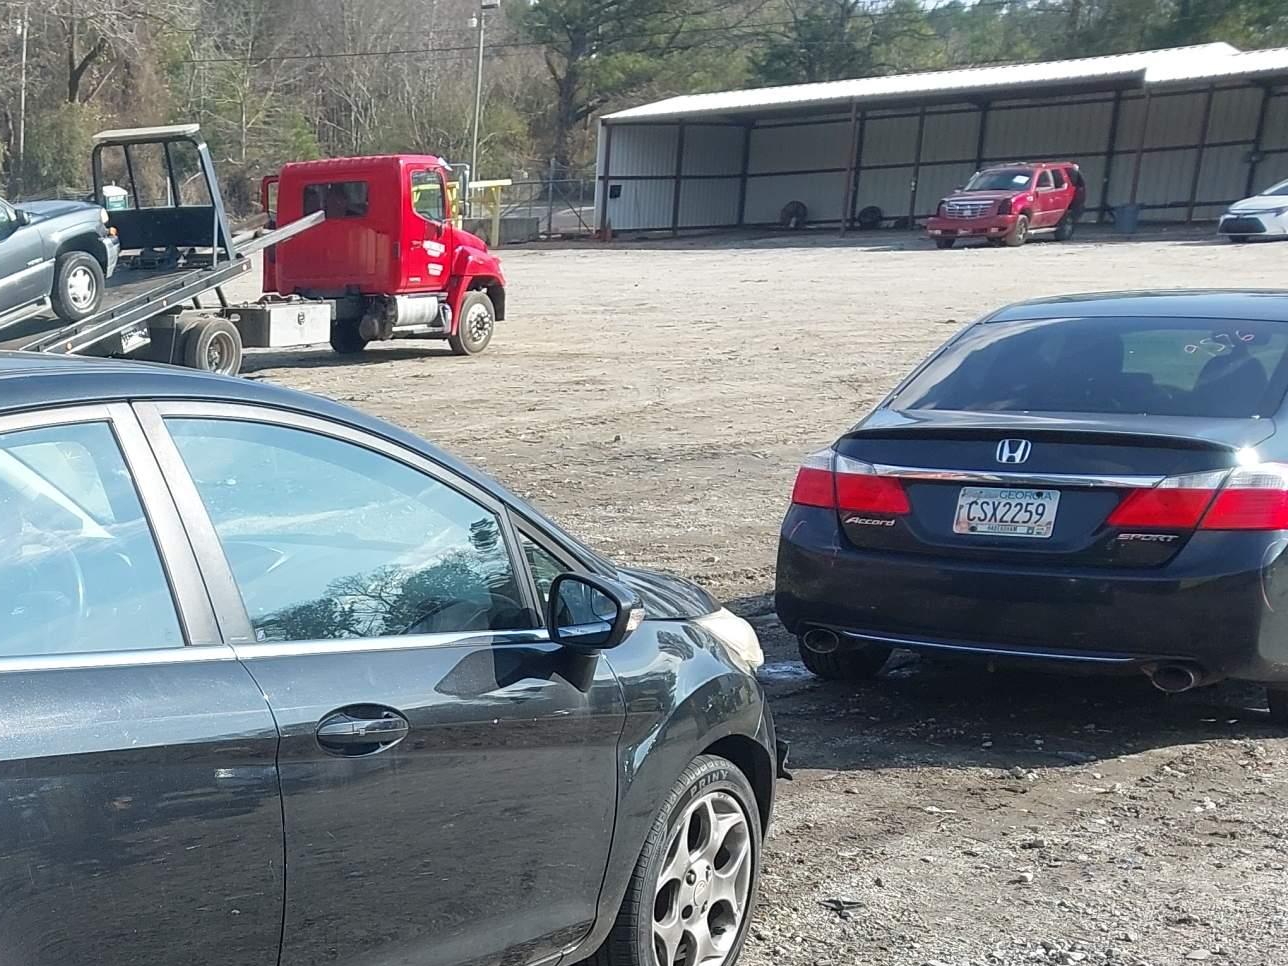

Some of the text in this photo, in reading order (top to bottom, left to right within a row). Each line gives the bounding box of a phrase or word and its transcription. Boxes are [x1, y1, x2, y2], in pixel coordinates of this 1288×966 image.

[967, 500, 1046, 524] CSX2259
[845, 515, 895, 527] Accord
[1115, 532, 1180, 543] SPORT
